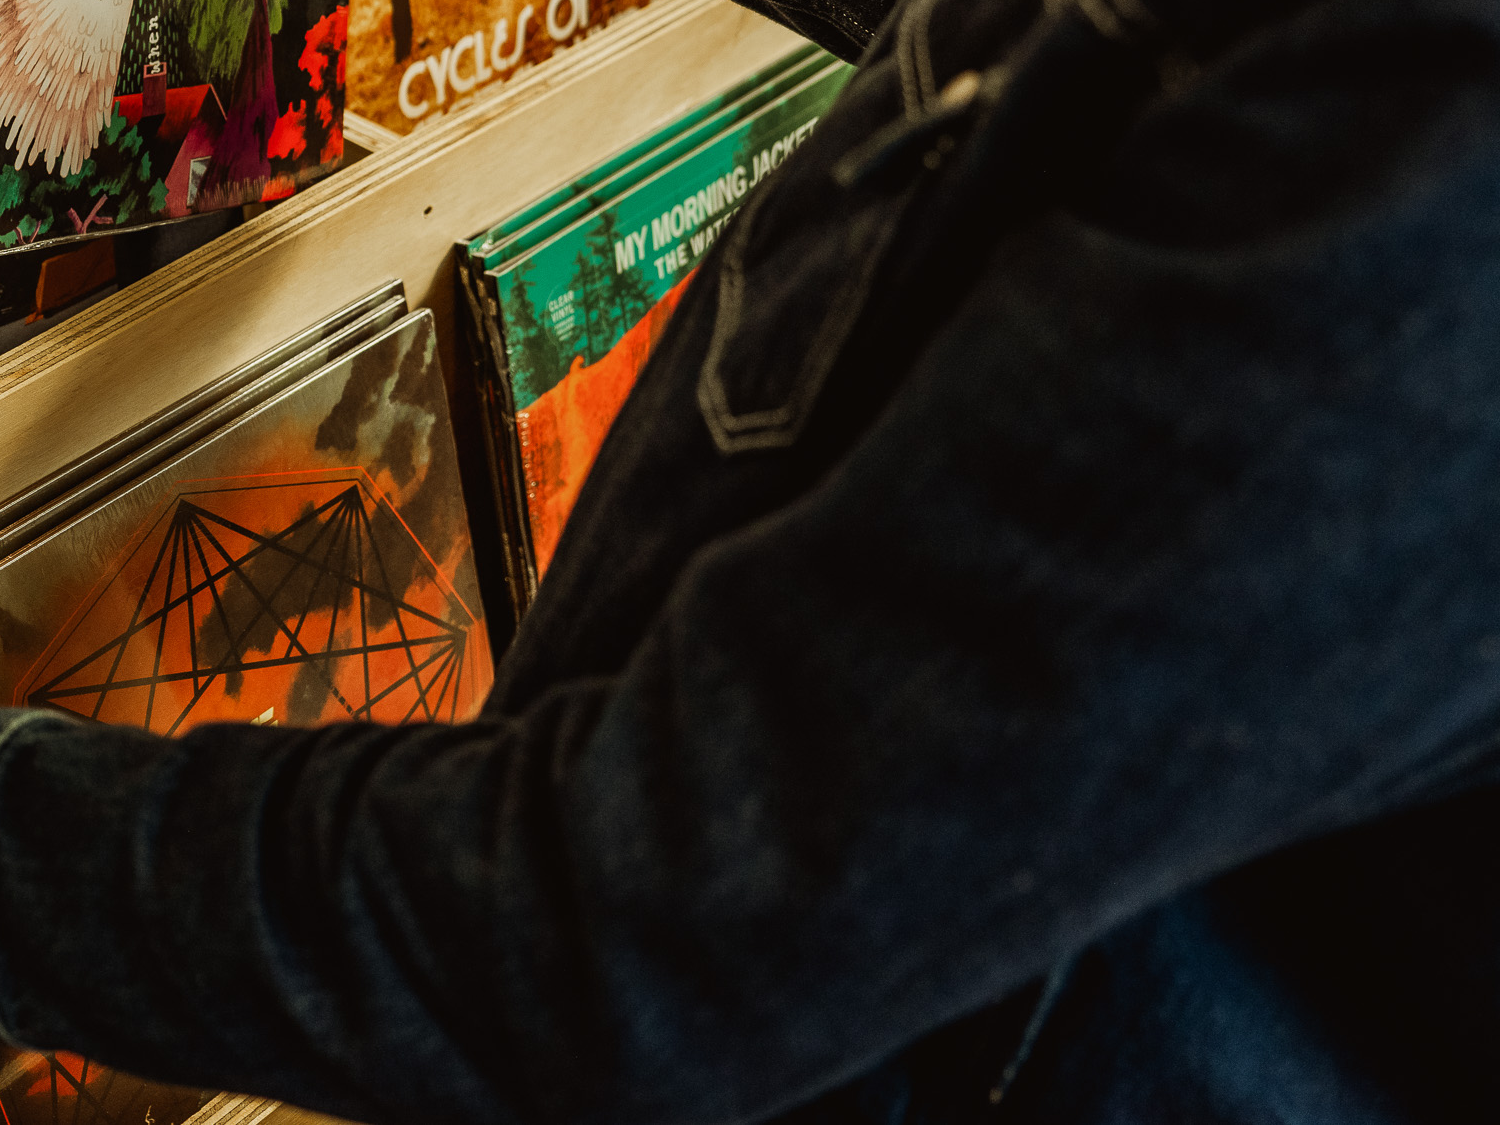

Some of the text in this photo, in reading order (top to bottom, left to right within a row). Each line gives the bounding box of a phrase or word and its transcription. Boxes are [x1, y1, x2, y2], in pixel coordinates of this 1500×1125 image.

[149, 14, 161, 75] when
[398, 4, 534, 119] CYCLES
[614, 116, 819, 274] MY MORNING JACKET
[653, 242, 690, 280] THE
